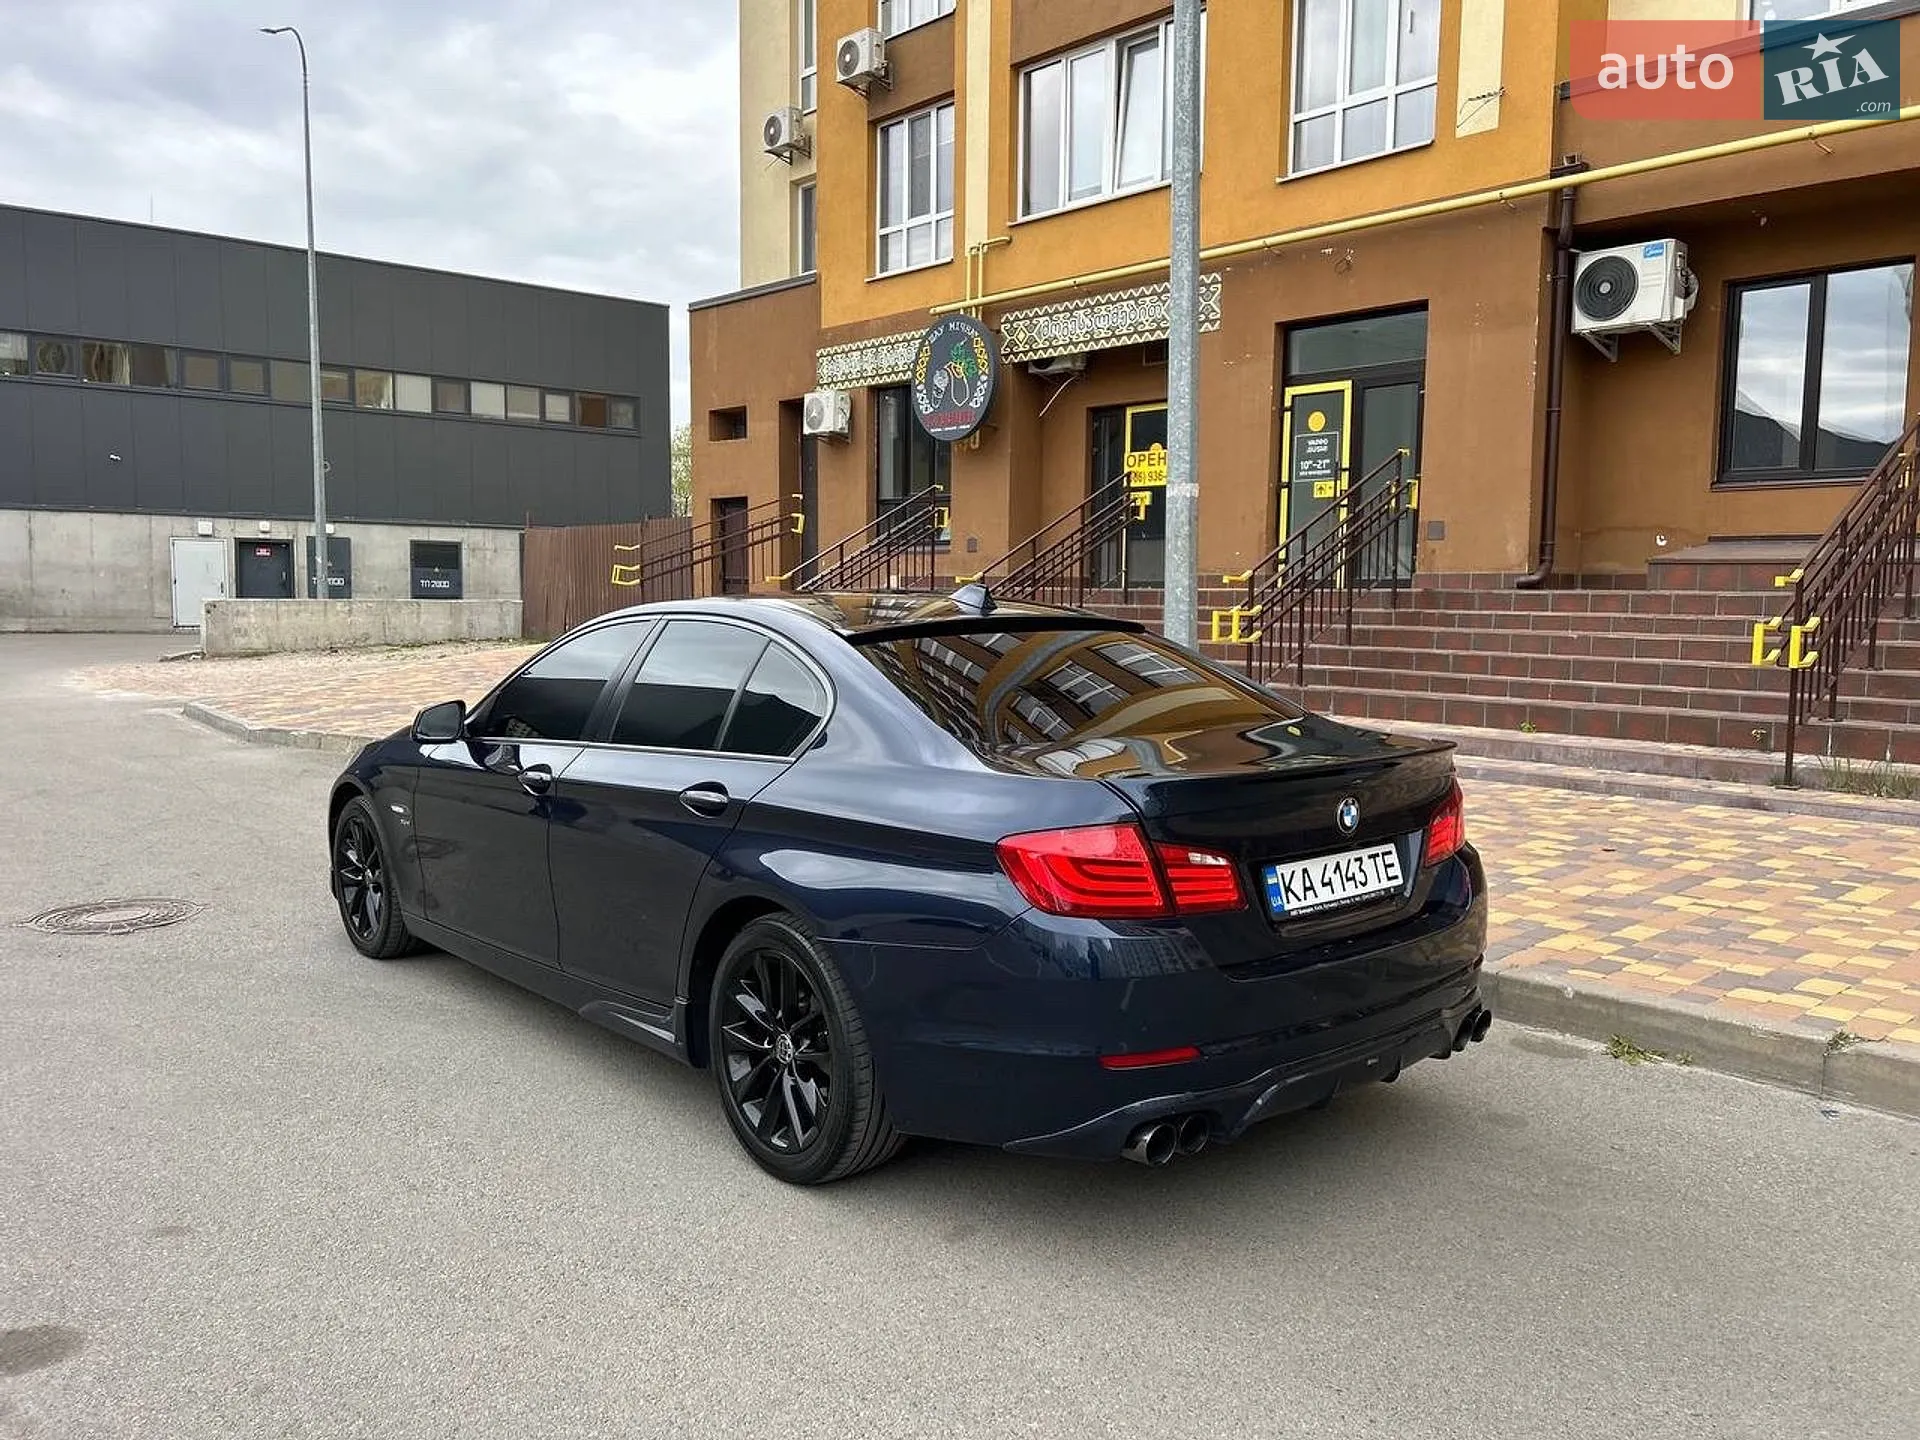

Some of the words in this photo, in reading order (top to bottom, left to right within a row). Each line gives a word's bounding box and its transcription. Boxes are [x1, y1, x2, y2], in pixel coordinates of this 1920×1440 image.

[1126, 452, 1167, 468] ОРЕН
[1280, 867, 1318, 905] KA
[1321, 857, 1368, 895] 4143
[1368, 850, 1399, 884] TE
[1271, 895, 1284, 907] UA
